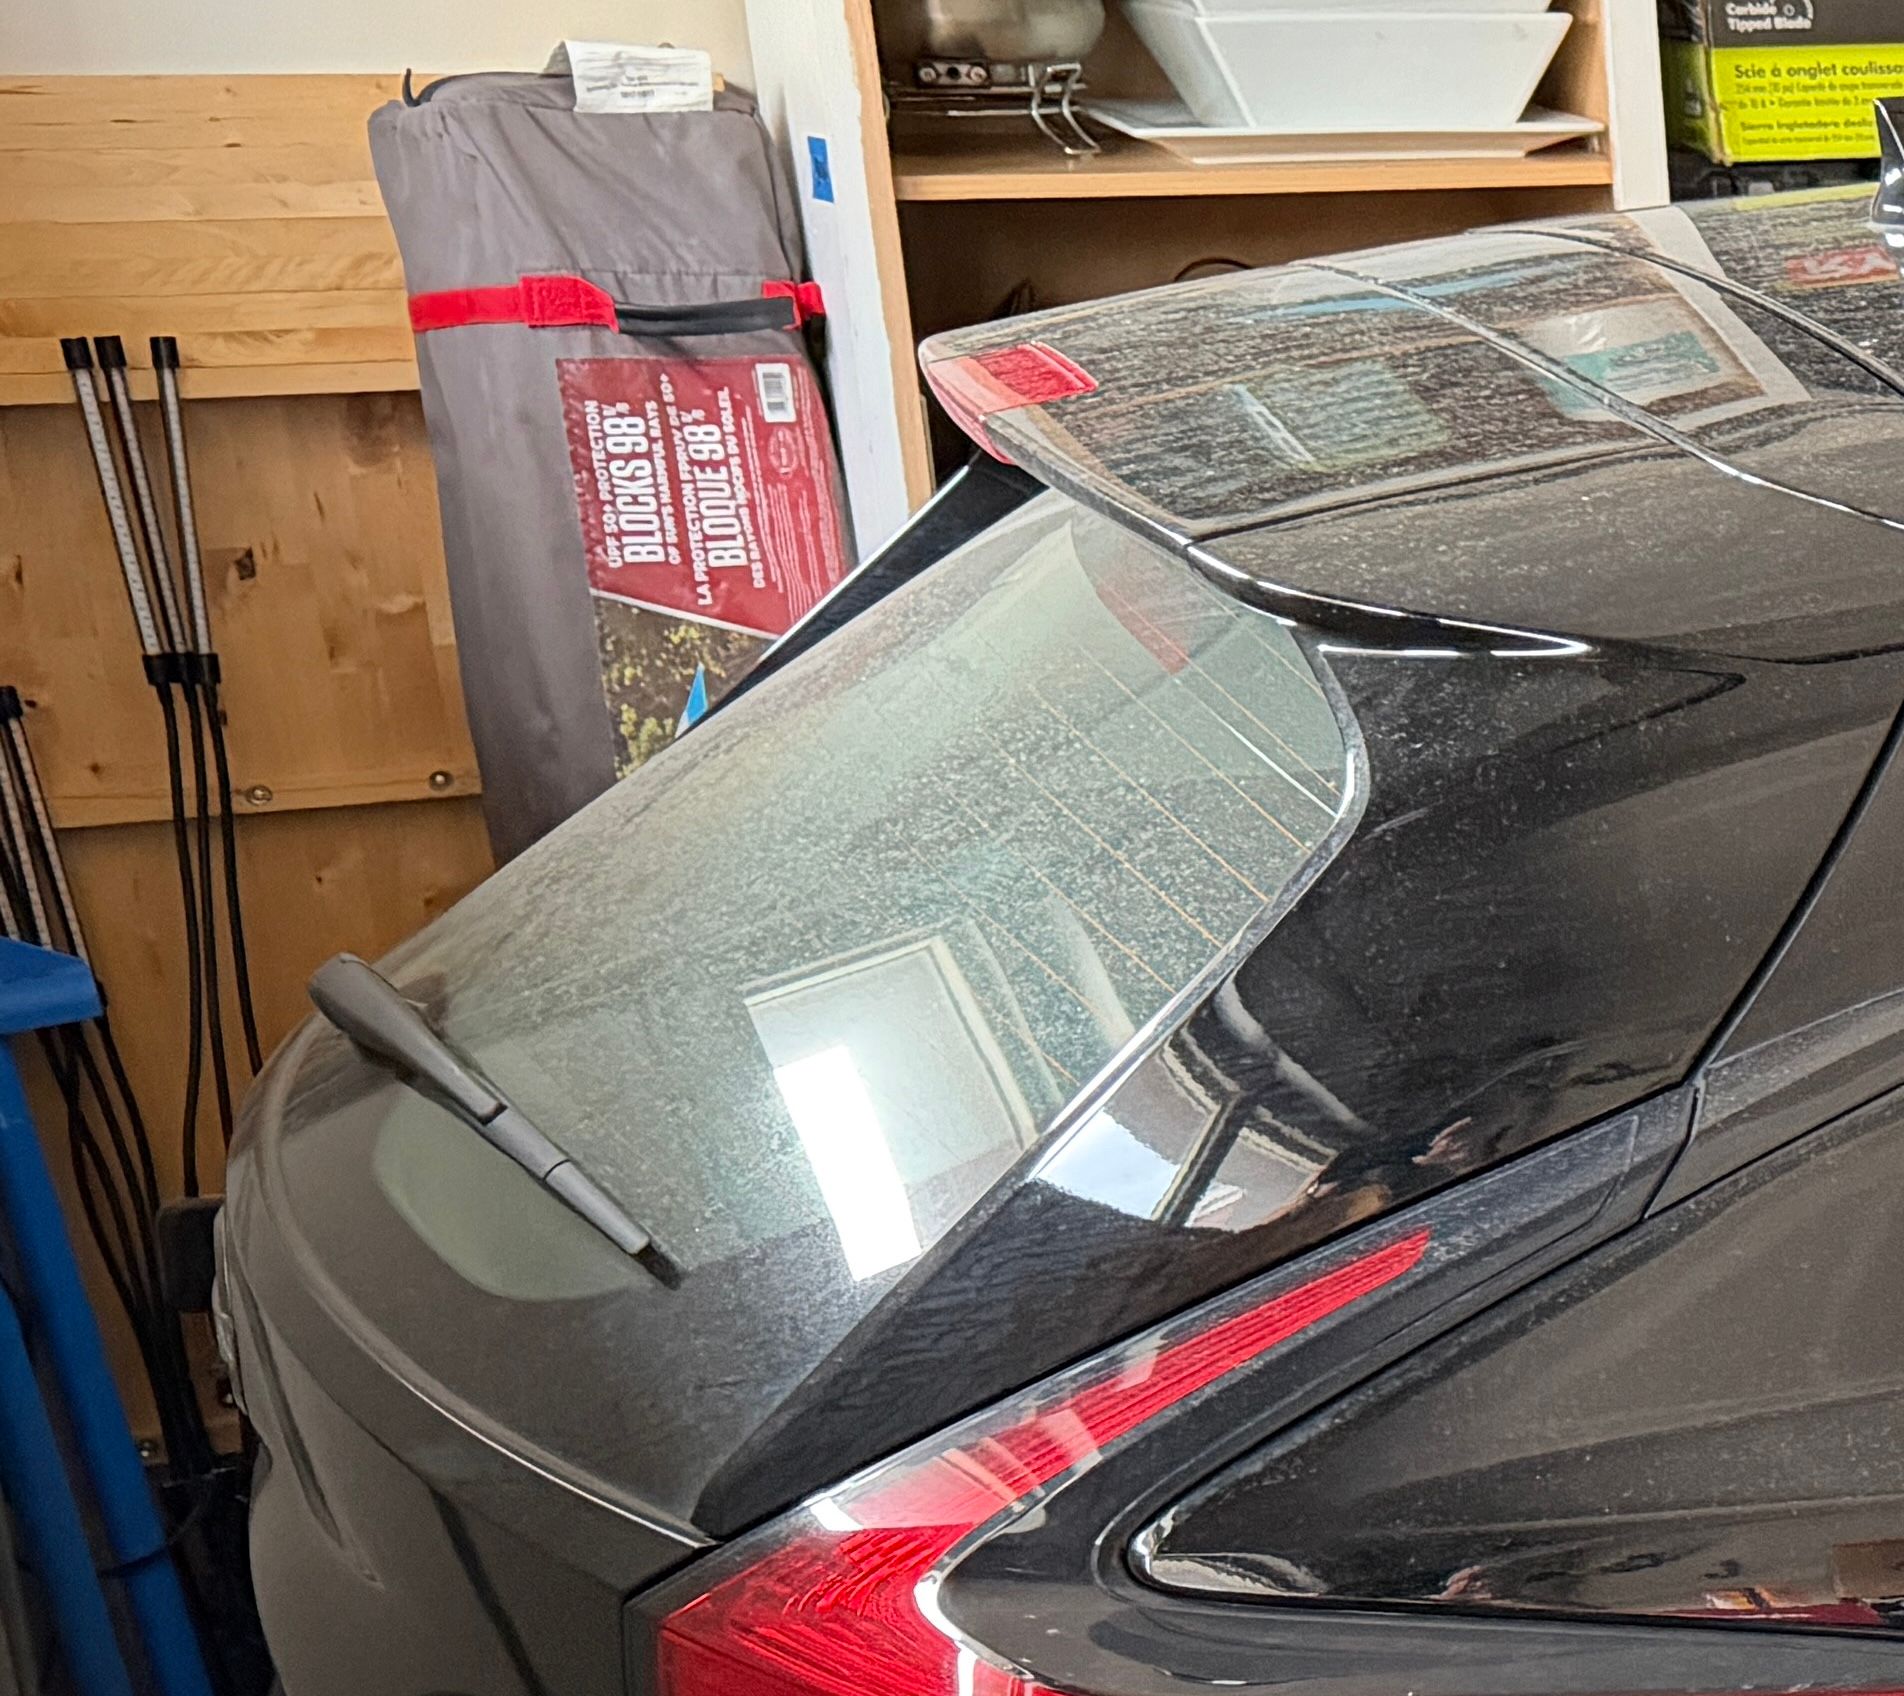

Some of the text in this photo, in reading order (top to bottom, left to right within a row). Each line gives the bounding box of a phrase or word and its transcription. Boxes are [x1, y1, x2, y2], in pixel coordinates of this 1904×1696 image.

[1727, 16, 1772, 33] Tipped
[1735, 64, 1766, 79] Scie
[1787, 60, 1838, 80] onglet
[644, 400, 663, 438] RAYS
[665, 405, 681, 427] DE
[716, 386, 736, 433] SOLEIL
[584, 400, 613, 501] PROTECTION
[724, 434, 740, 455] DU
[651, 439, 673, 504] HARMFUL
[608, 458, 666, 563] BLOCKS
[692, 465, 749, 568] BLOQUE
[681, 482, 710, 582] PROTECTION
[739, 506, 762, 560] RAYONS
[605, 535, 624, 569] UPF
[666, 545, 682, 565] OF
[750, 561, 766, 589] DES
[695, 583, 713, 605] LA
